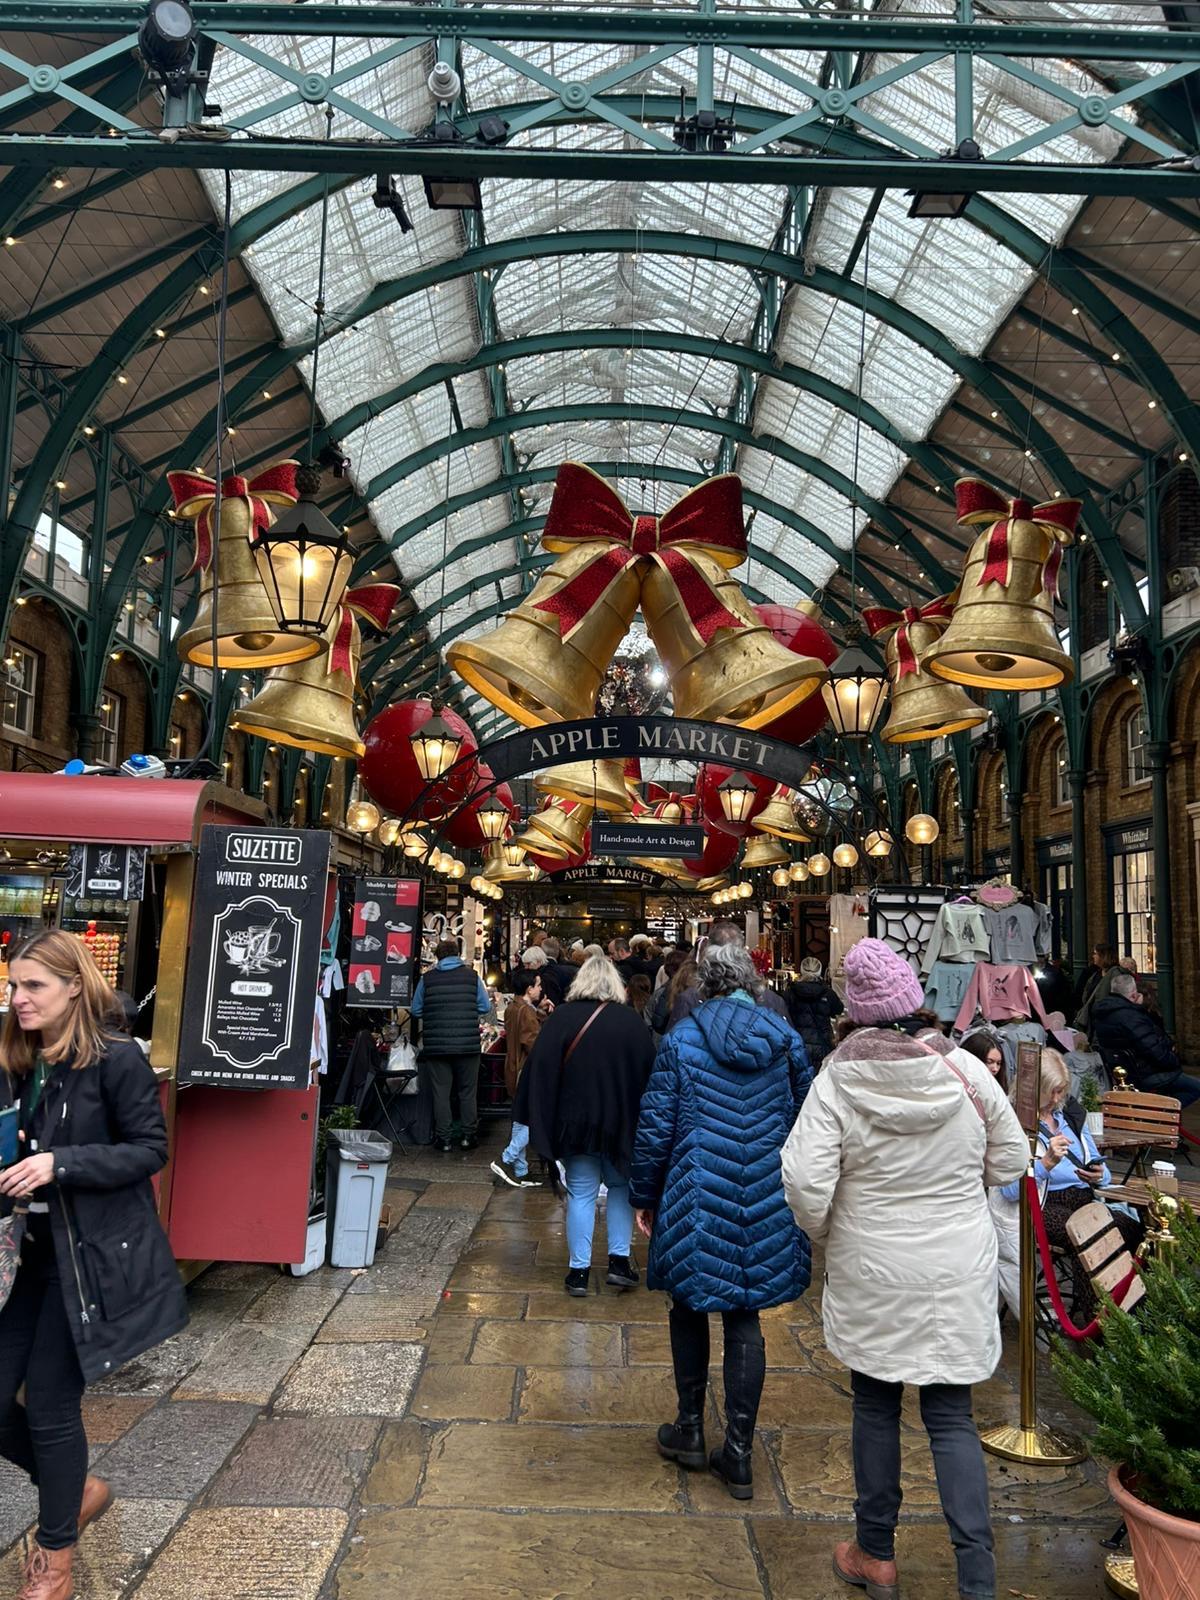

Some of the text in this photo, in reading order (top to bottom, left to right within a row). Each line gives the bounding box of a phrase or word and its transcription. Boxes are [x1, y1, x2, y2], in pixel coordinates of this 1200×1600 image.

[529, 726, 775, 767] APPLE MARKET
[232, 838, 296, 861] SUZETTE
[599, 834, 696, 847] Hand-made Art & Design
[216, 870, 308, 890] WINTER SPECIALS
[563, 867, 657, 884] APPLE MARKET
[238, 984, 267, 993] HOT DRINKS
